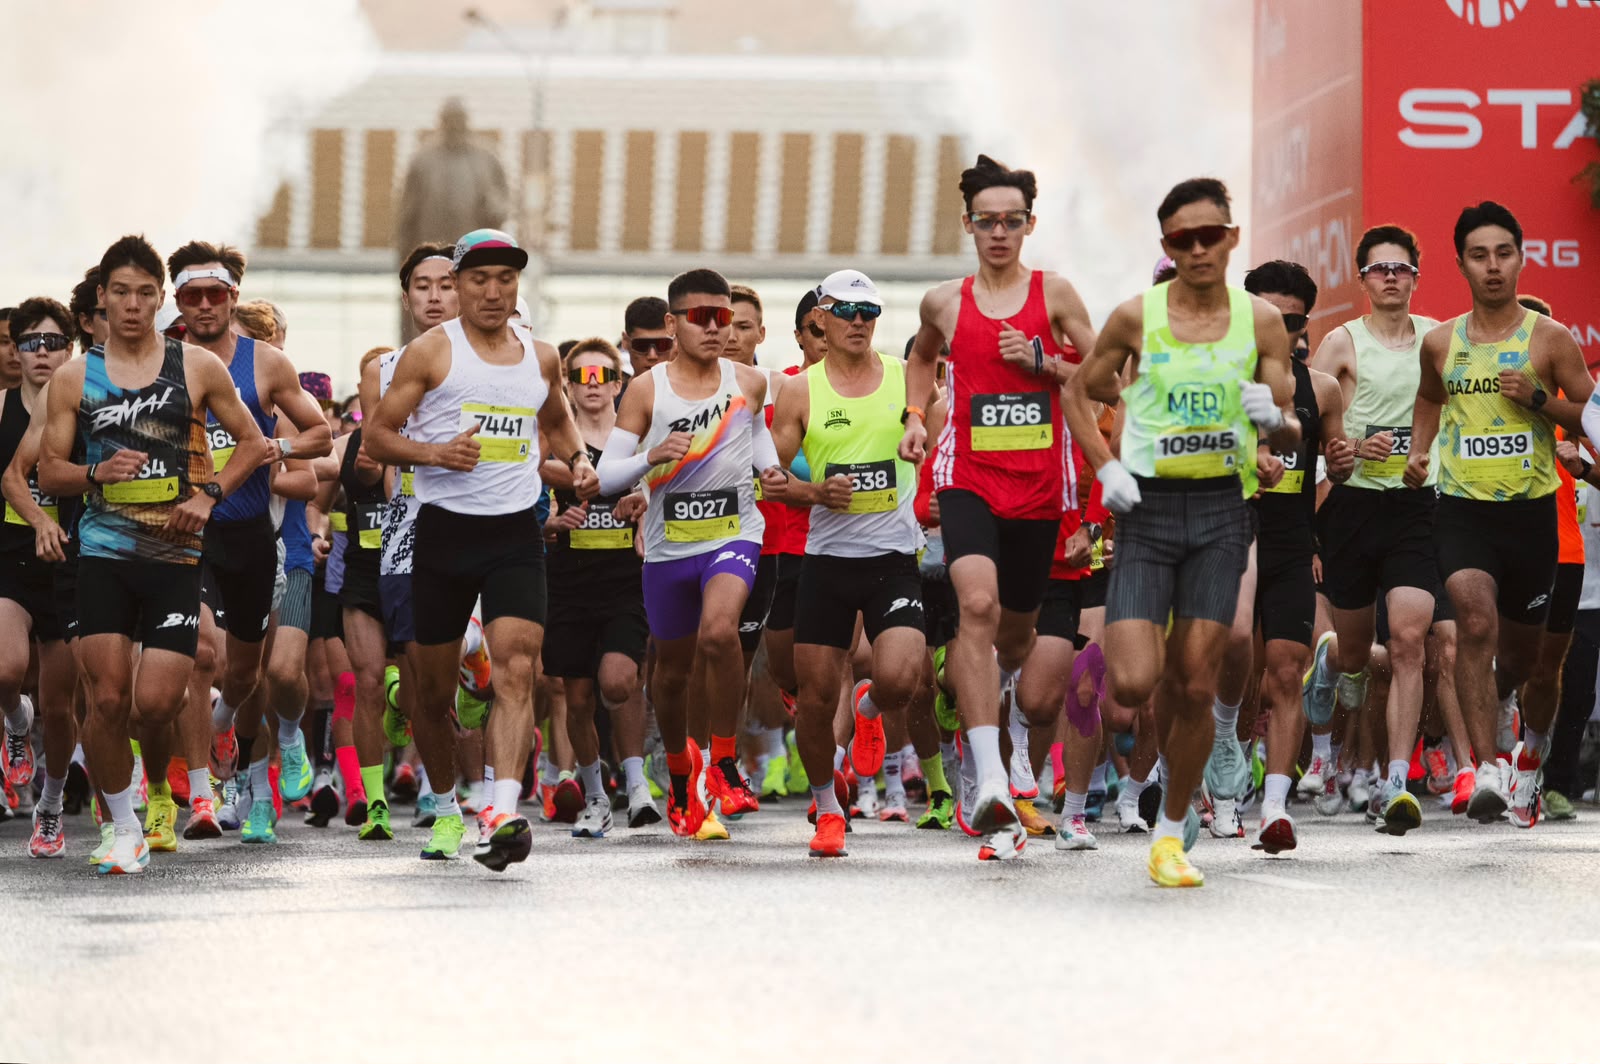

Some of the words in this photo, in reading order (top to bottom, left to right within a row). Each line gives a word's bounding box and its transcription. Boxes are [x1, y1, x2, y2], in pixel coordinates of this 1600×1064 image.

[1168, 392, 1217, 412] MED
[830, 410, 843, 418] SN
[982, 403, 1041, 426] 8766
[474, 415, 523, 437] 7441
[1041, 430, 1048, 440] A
[520, 444, 527, 454] A
[1160, 432, 1234, 456] 10945
[1465, 434, 1527, 456] 10939
[1226, 456, 1234, 466] A
[1523, 459, 1531, 469] A
[834, 470, 888, 492] 538
[167, 482, 174, 492] A
[888, 494, 895, 503] A
[674, 498, 728, 520] 9027
[728, 521, 735, 530] A
[623, 532, 630, 541] A
